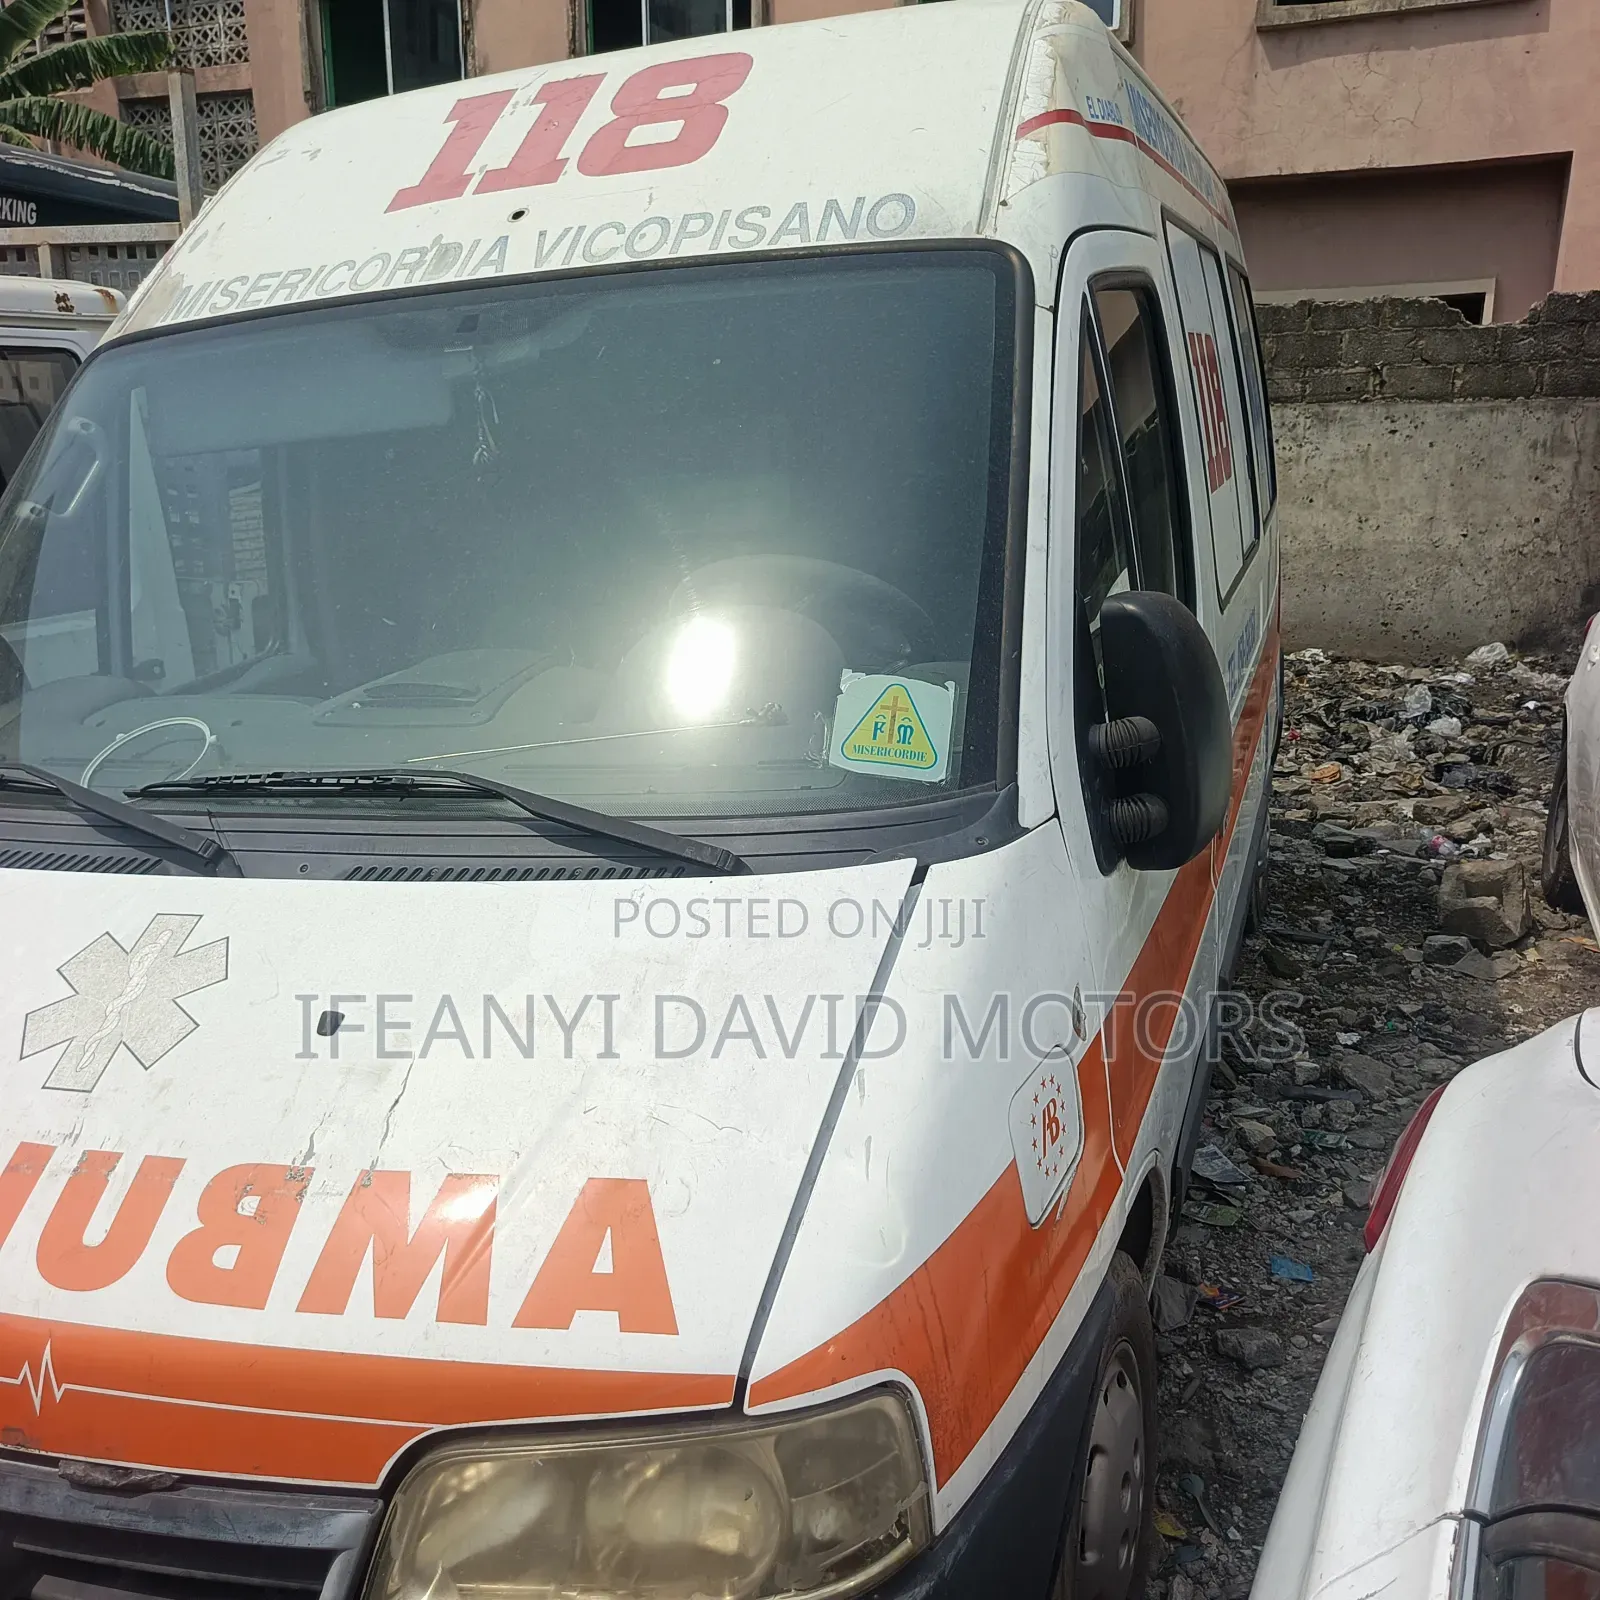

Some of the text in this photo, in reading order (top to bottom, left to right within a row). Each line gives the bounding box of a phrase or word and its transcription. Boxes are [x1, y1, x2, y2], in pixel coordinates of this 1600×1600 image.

[385, 52, 754, 213] 118
[0, 197, 37, 225] KING
[160, 193, 916, 323] MISERICORDIA VICOPISANO
[1187, 331, 1232, 495] 118
[852, 744, 928, 763] MISERICORDIE
